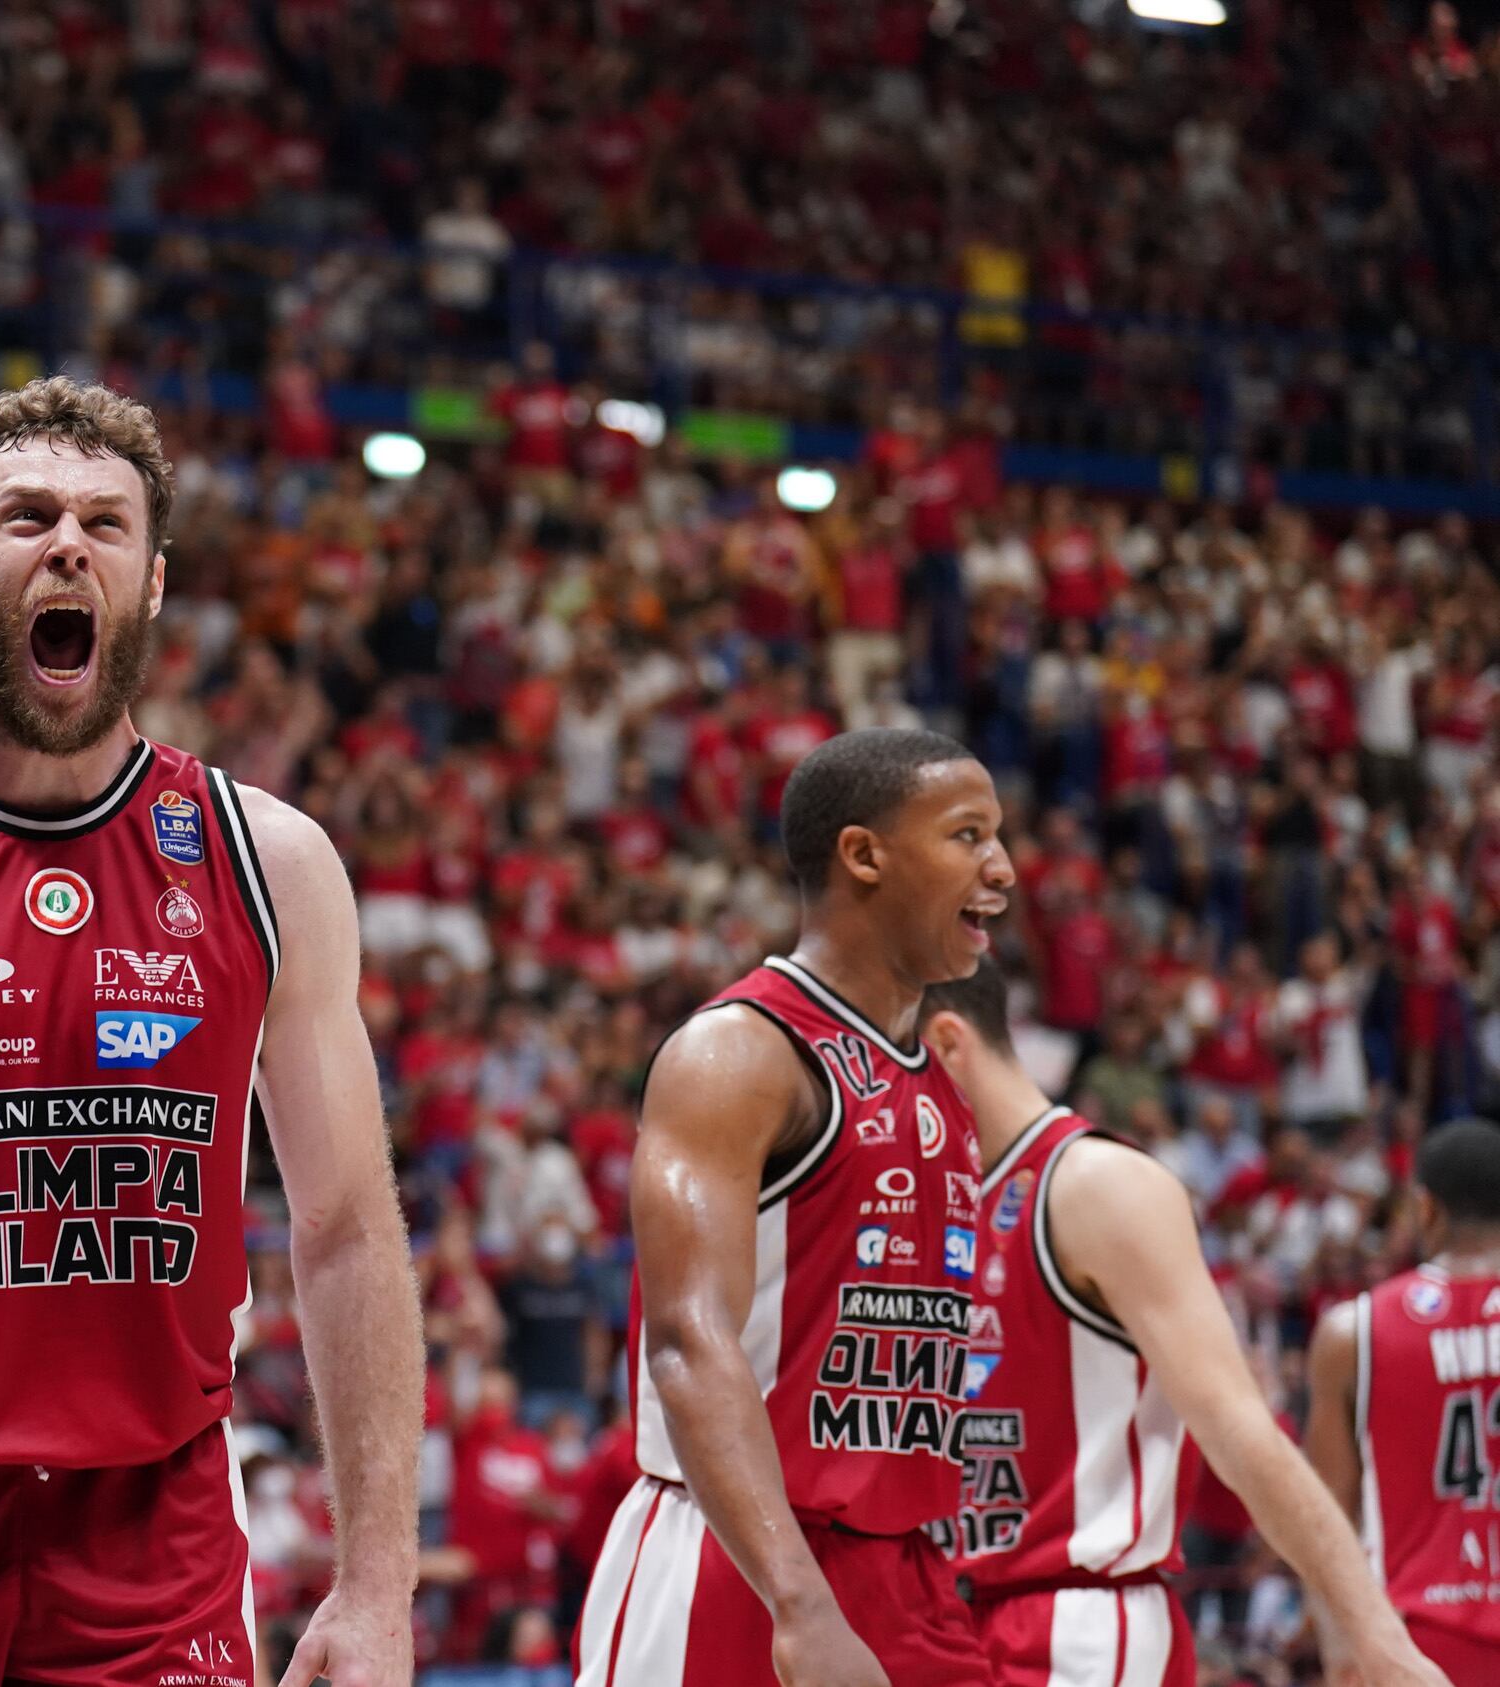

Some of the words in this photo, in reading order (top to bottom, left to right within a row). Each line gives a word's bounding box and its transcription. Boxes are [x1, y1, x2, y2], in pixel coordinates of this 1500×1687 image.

[161, 819, 198, 835] LBA
[94, 988, 204, 1008] FRAGRANCES
[97, 1021, 176, 1059] SAP
[47, 1096, 211, 1134] EXCHANGE
[158, 1675, 206, 1686] ARMANI
[210, 1675, 247, 1687] EXCHANGE
